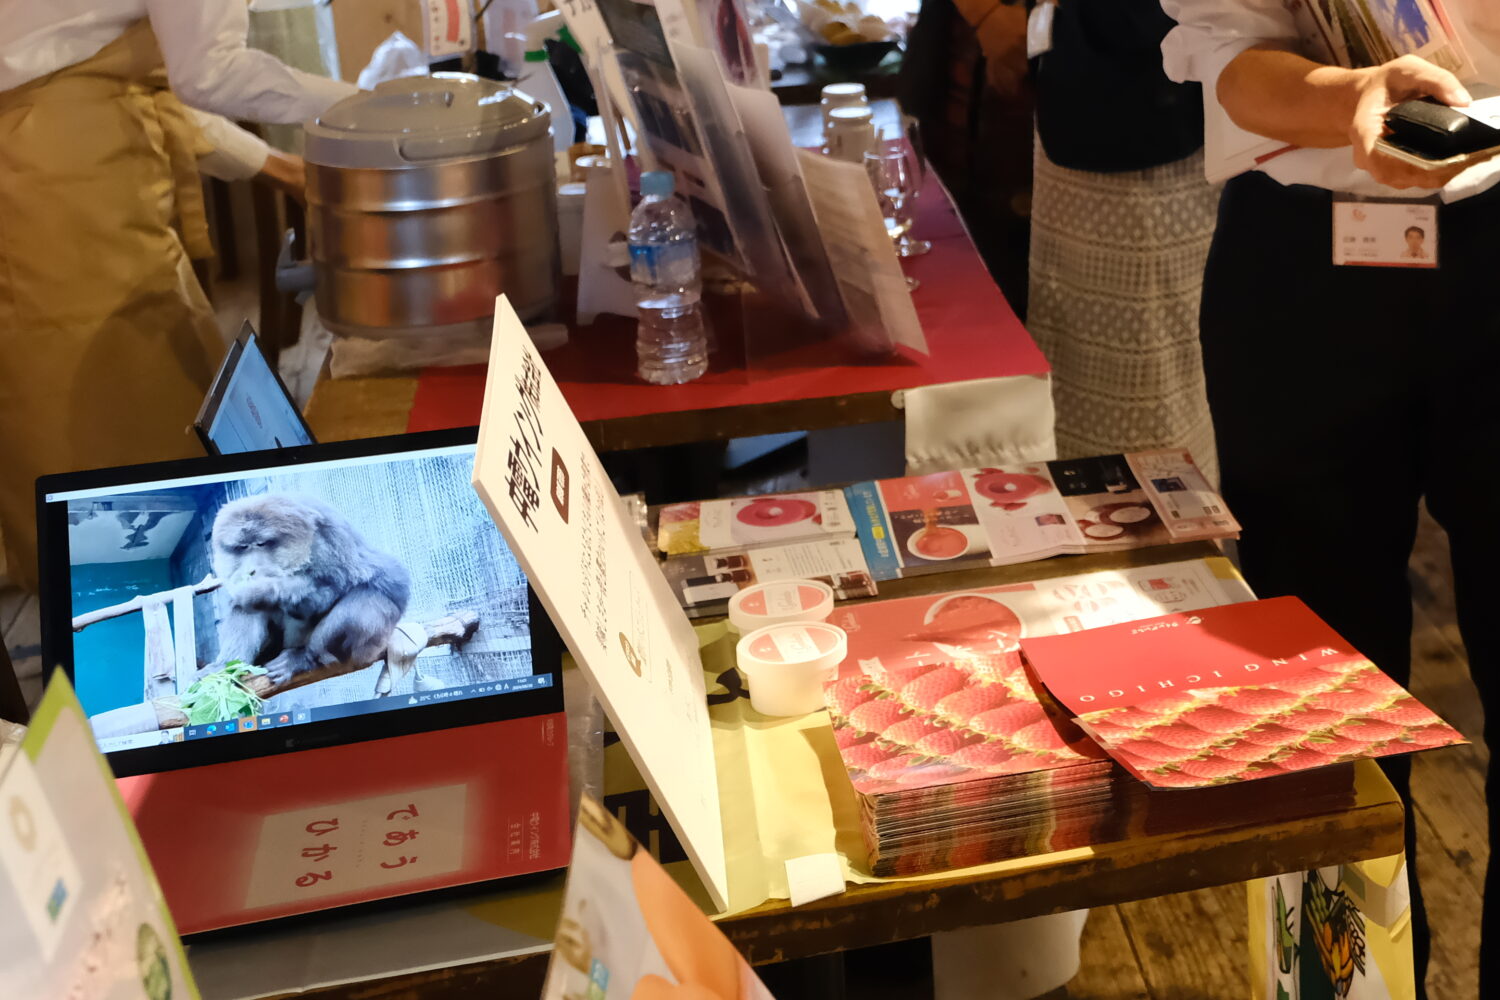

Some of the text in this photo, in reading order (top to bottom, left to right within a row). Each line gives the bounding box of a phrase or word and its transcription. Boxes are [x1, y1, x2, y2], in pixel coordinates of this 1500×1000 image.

[1079, 645, 1338, 703] WING ICHIGO
[295, 817, 339, 888] ひかる
[380, 803, 419, 869] であう
